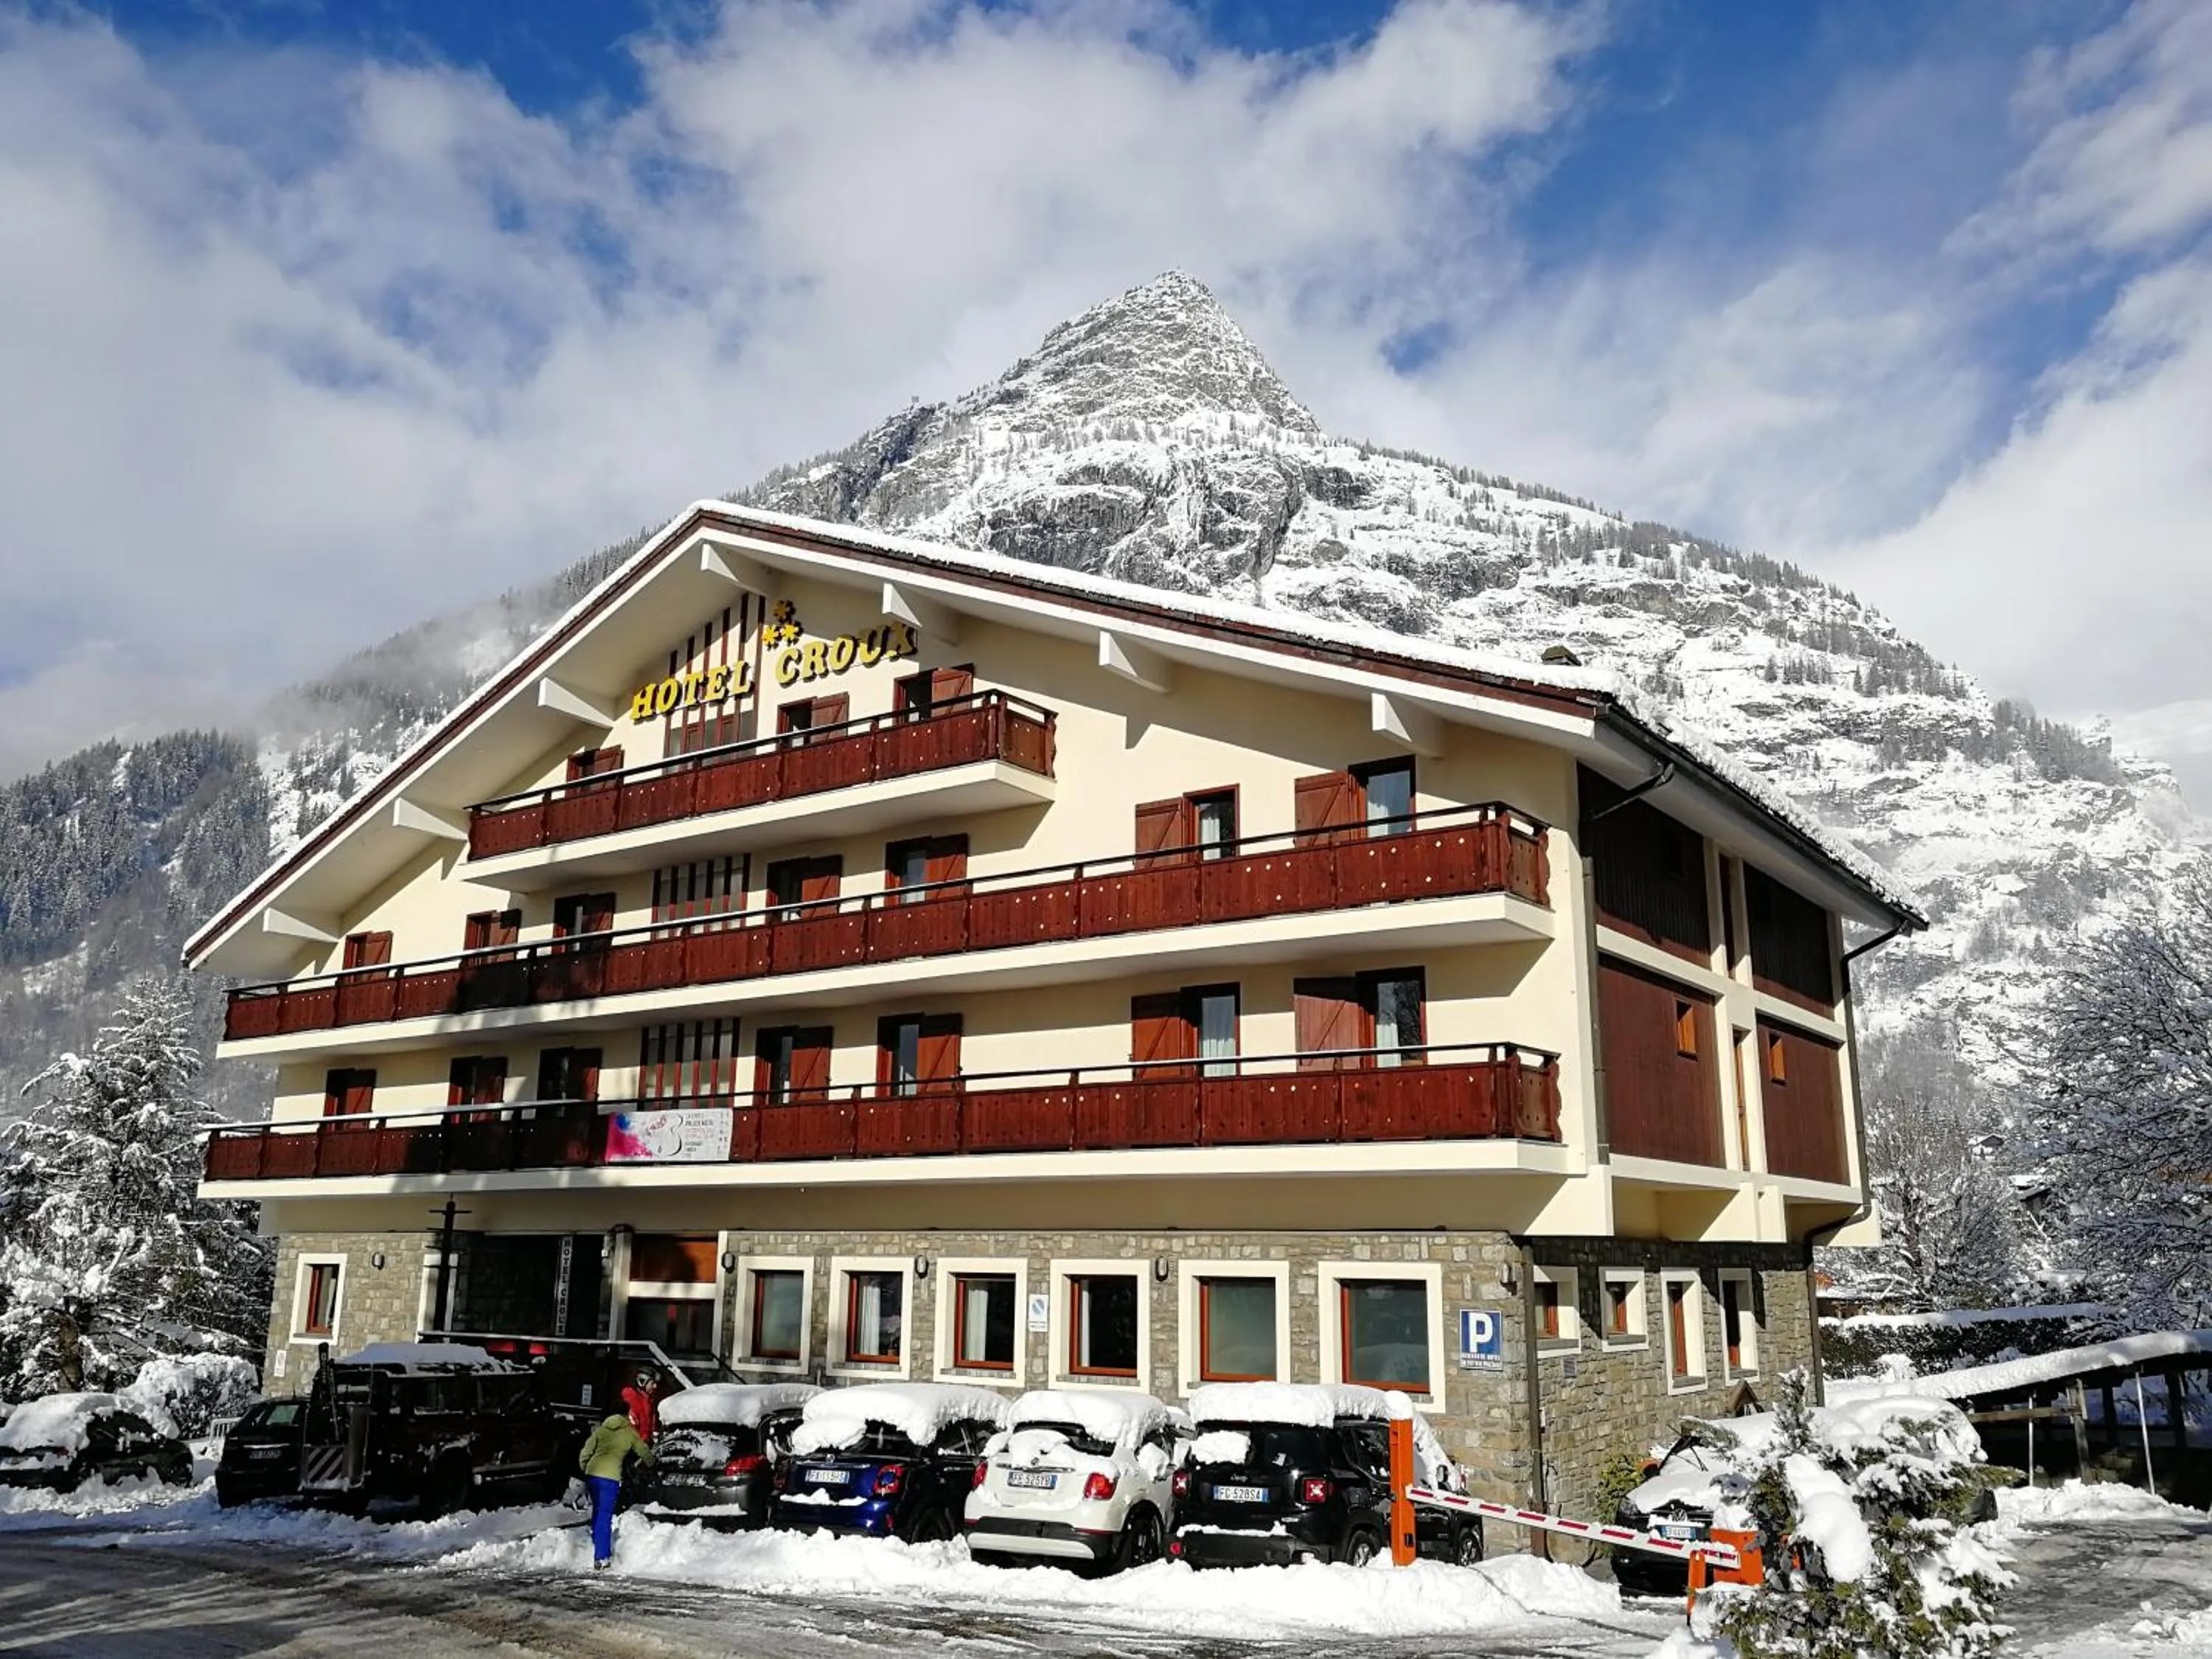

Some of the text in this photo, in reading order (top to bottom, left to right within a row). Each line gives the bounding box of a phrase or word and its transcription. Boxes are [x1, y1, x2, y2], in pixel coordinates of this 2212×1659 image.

[630, 621, 916, 720] HOTEL CROUX
[562, 1239, 571, 1284] HOTEL
[1468, 1312, 1493, 1353] P
